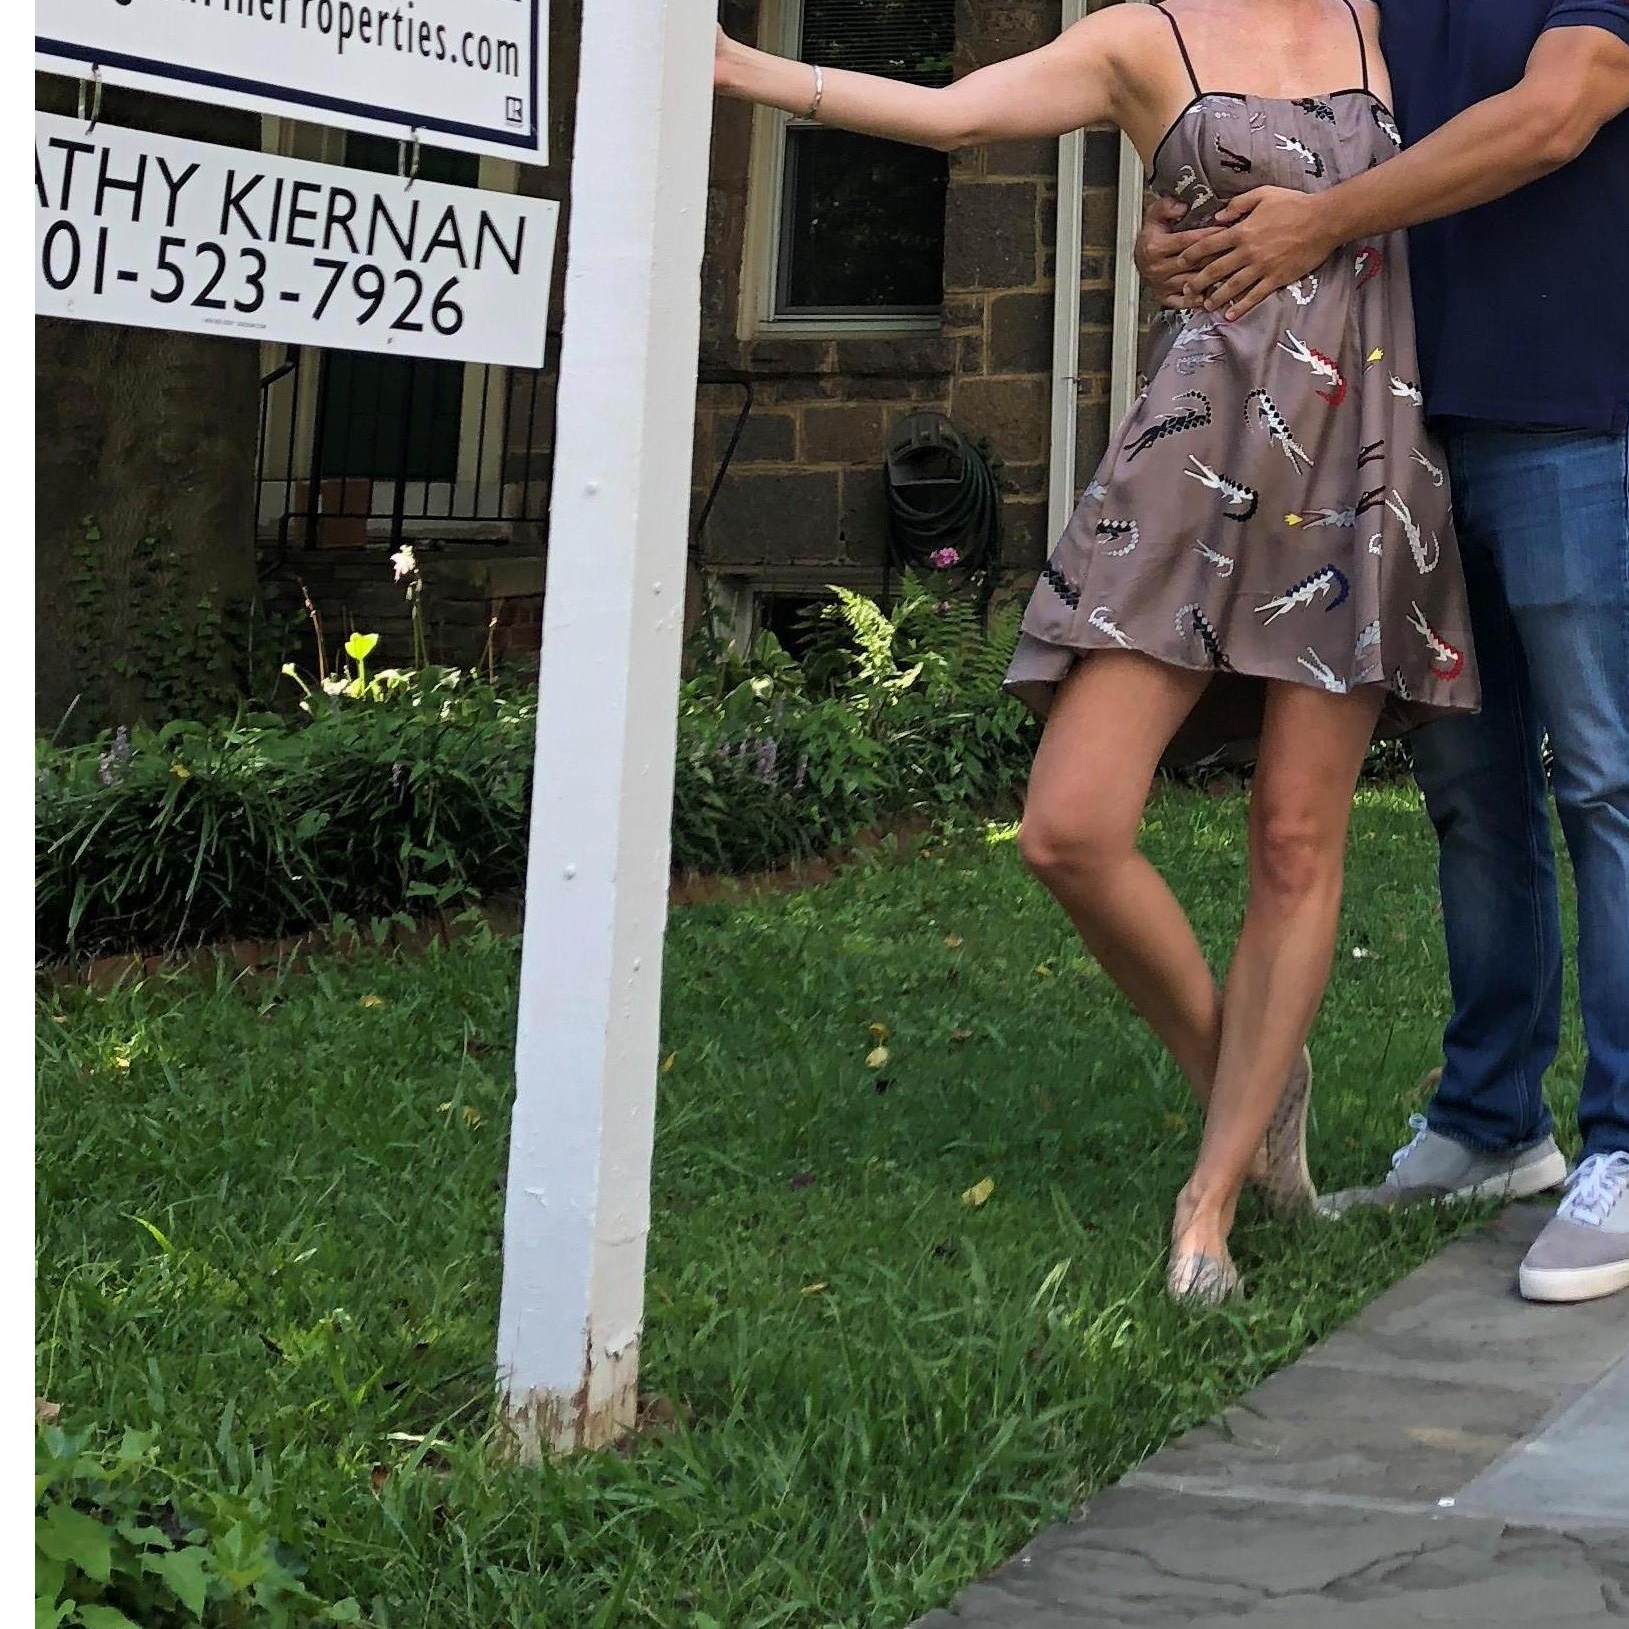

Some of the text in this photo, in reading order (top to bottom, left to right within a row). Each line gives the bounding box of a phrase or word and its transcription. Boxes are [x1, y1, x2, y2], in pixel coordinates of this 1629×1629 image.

[35, 137, 527, 275] THY KIERNAN
[42, 219, 465, 336] 01-523-7926
